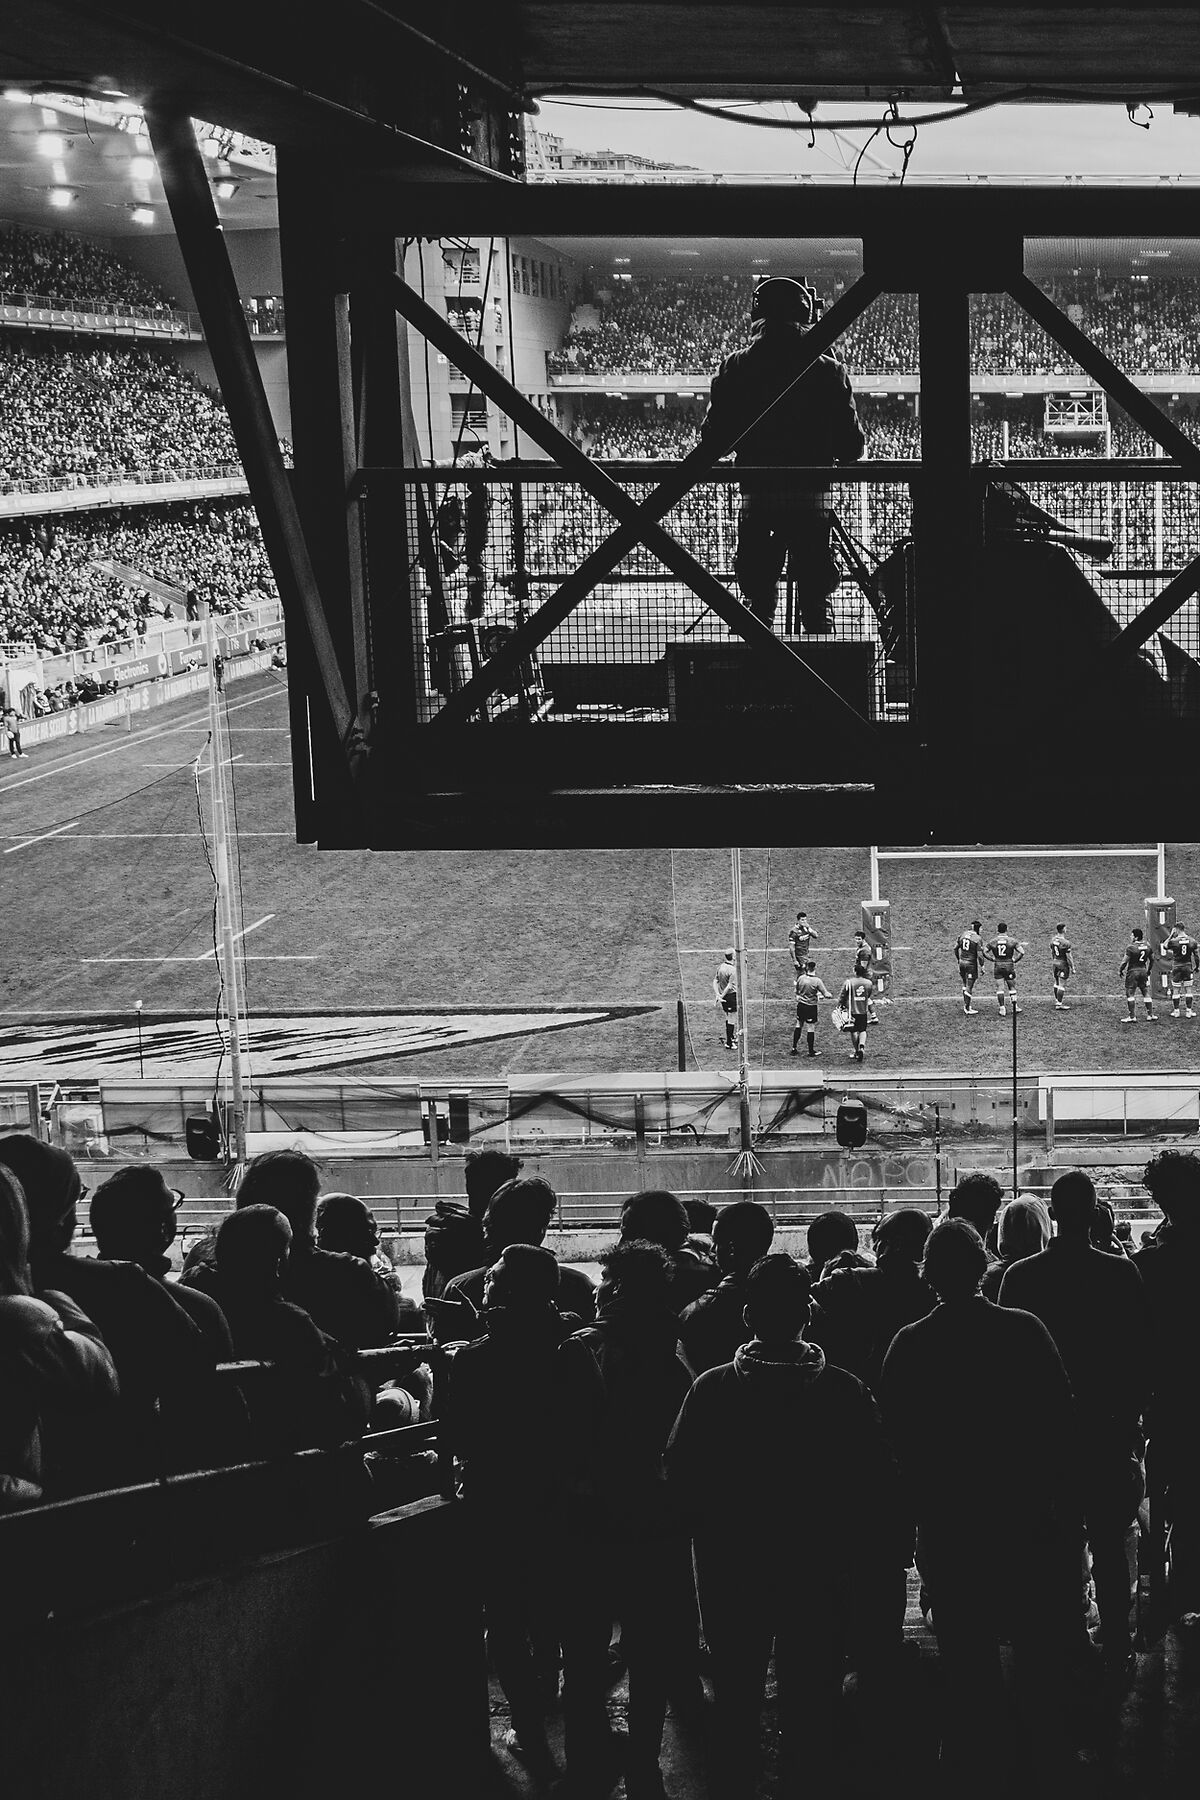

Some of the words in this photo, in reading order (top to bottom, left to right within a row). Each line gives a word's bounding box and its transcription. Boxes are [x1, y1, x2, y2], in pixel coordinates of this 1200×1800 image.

[962, 938, 970, 950] 13
[1181, 944, 1187, 955] 8
[997, 944, 1006, 956] 12
[1139, 950, 1146, 961] 2
